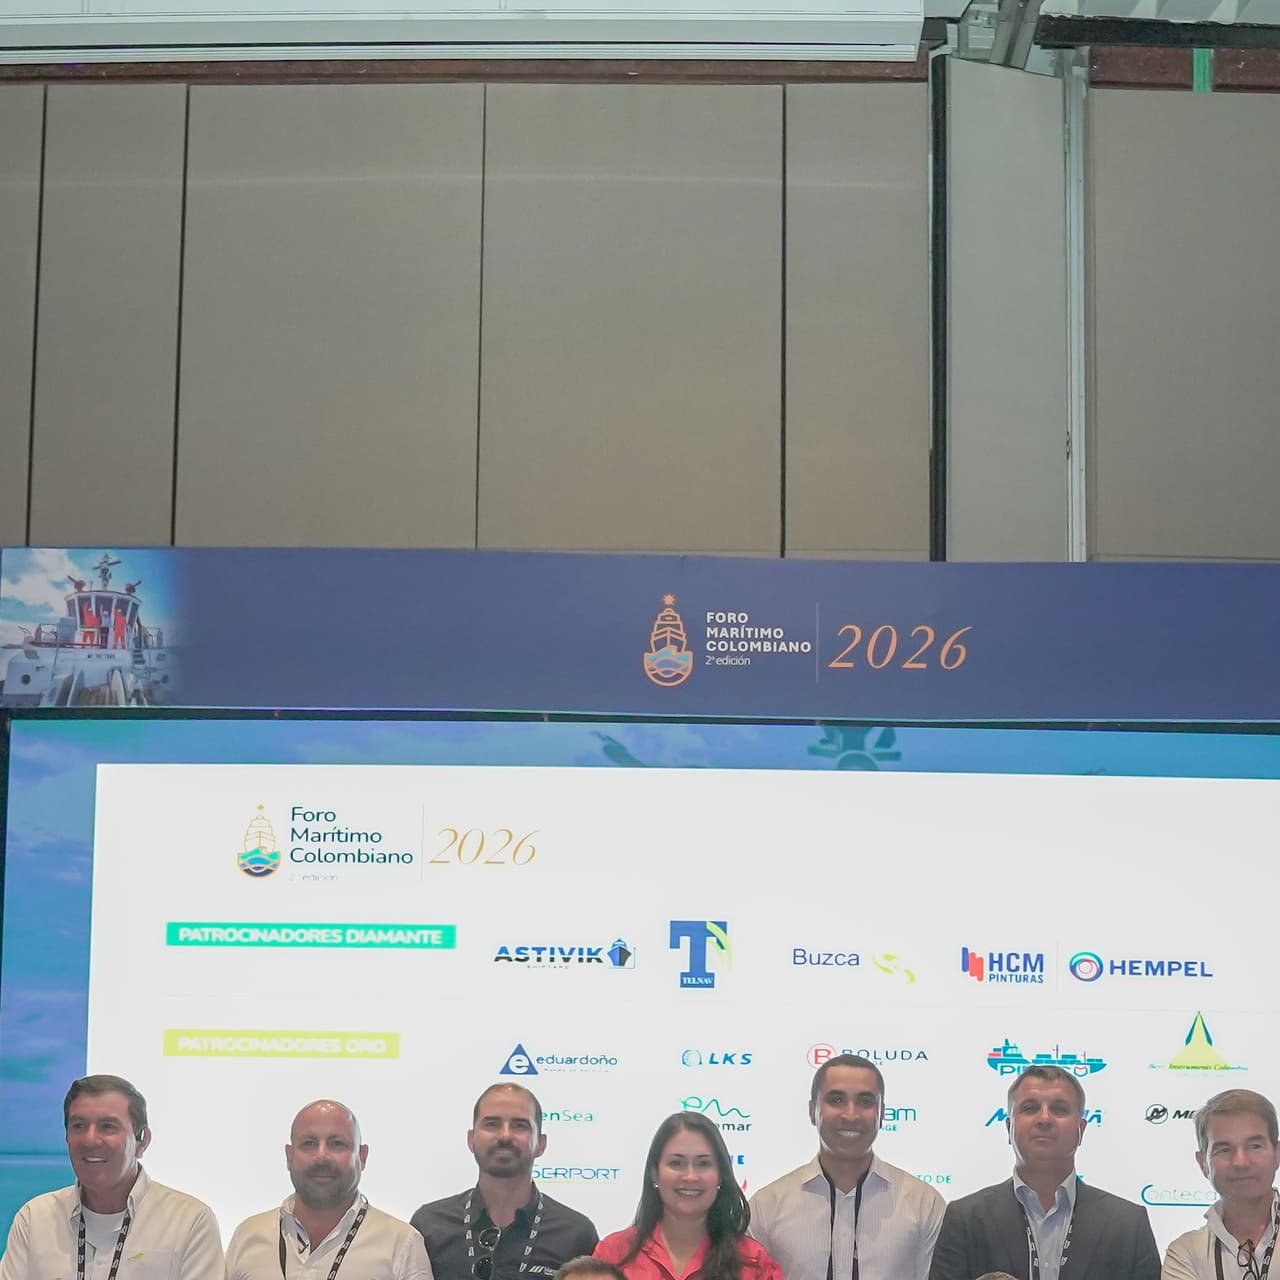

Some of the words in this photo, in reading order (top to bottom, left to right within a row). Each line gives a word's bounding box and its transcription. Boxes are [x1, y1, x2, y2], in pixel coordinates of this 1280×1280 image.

[706, 612, 748, 624] FORO
[706, 625, 784, 639] MARÍTIMO
[706, 640, 812, 653] COLOMBIANO
[828, 624, 973, 669] 2026
[716, 655, 751, 666] edición
[291, 806, 337, 823] Foro
[290, 826, 383, 843] Marítimo
[429, 827, 543, 866] 2026
[290, 847, 413, 865] Colombiano
[178, 927, 343, 944] PATROCINADORES
[346, 928, 443, 945] DIAMANTE
[494, 946, 604, 963] ASTIVIK
[793, 948, 860, 966] Buzca
[989, 952, 1044, 973] HCM
[1109, 959, 1213, 977] HEMPEL
[682, 976, 713, 985] TELNAV
[989, 974, 1044, 984] PINTURAS
[178, 1036, 341, 1054] PATROCINADORES
[345, 1038, 386, 1054] ORO
[537, 1054, 618, 1066] eduardoño
[709, 1053, 752, 1065] LKS
